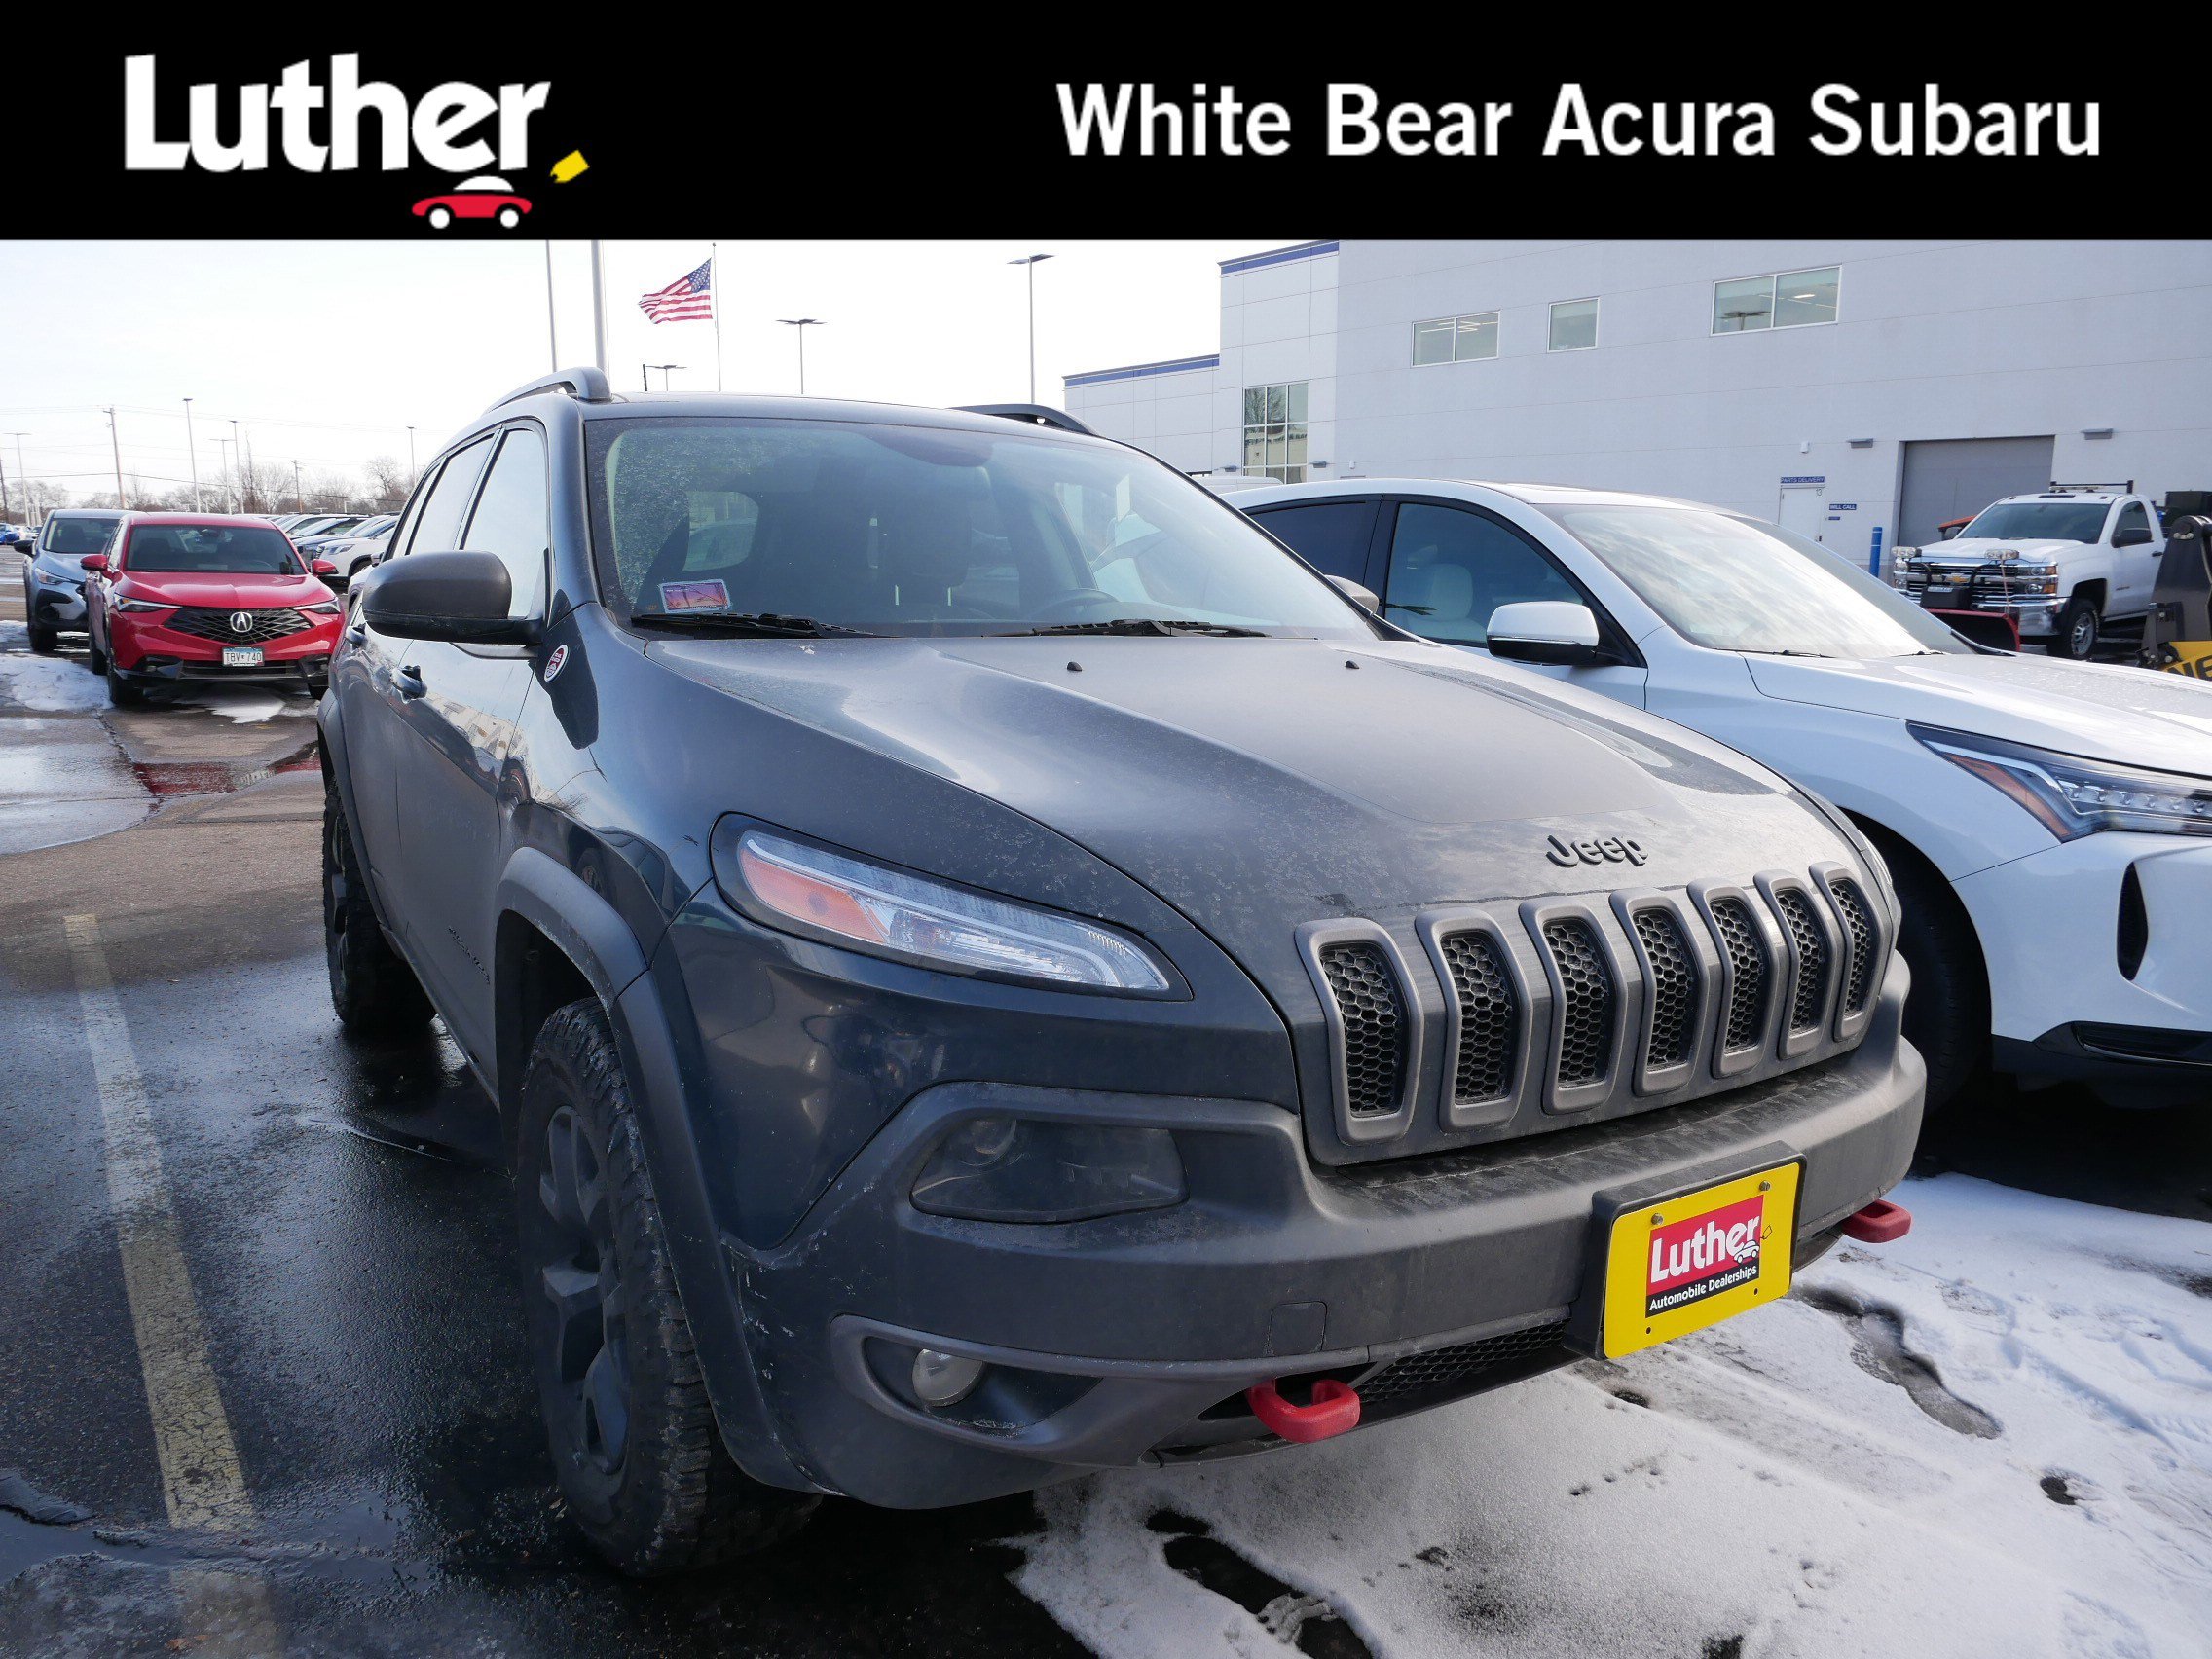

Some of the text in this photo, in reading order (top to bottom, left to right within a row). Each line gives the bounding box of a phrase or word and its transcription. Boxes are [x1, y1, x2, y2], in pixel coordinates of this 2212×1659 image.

[1546, 834, 1648, 868] Jeep
[1650, 1215, 1760, 1284] Luther
[1649, 1265, 1757, 1311] Automobile Dealerships
